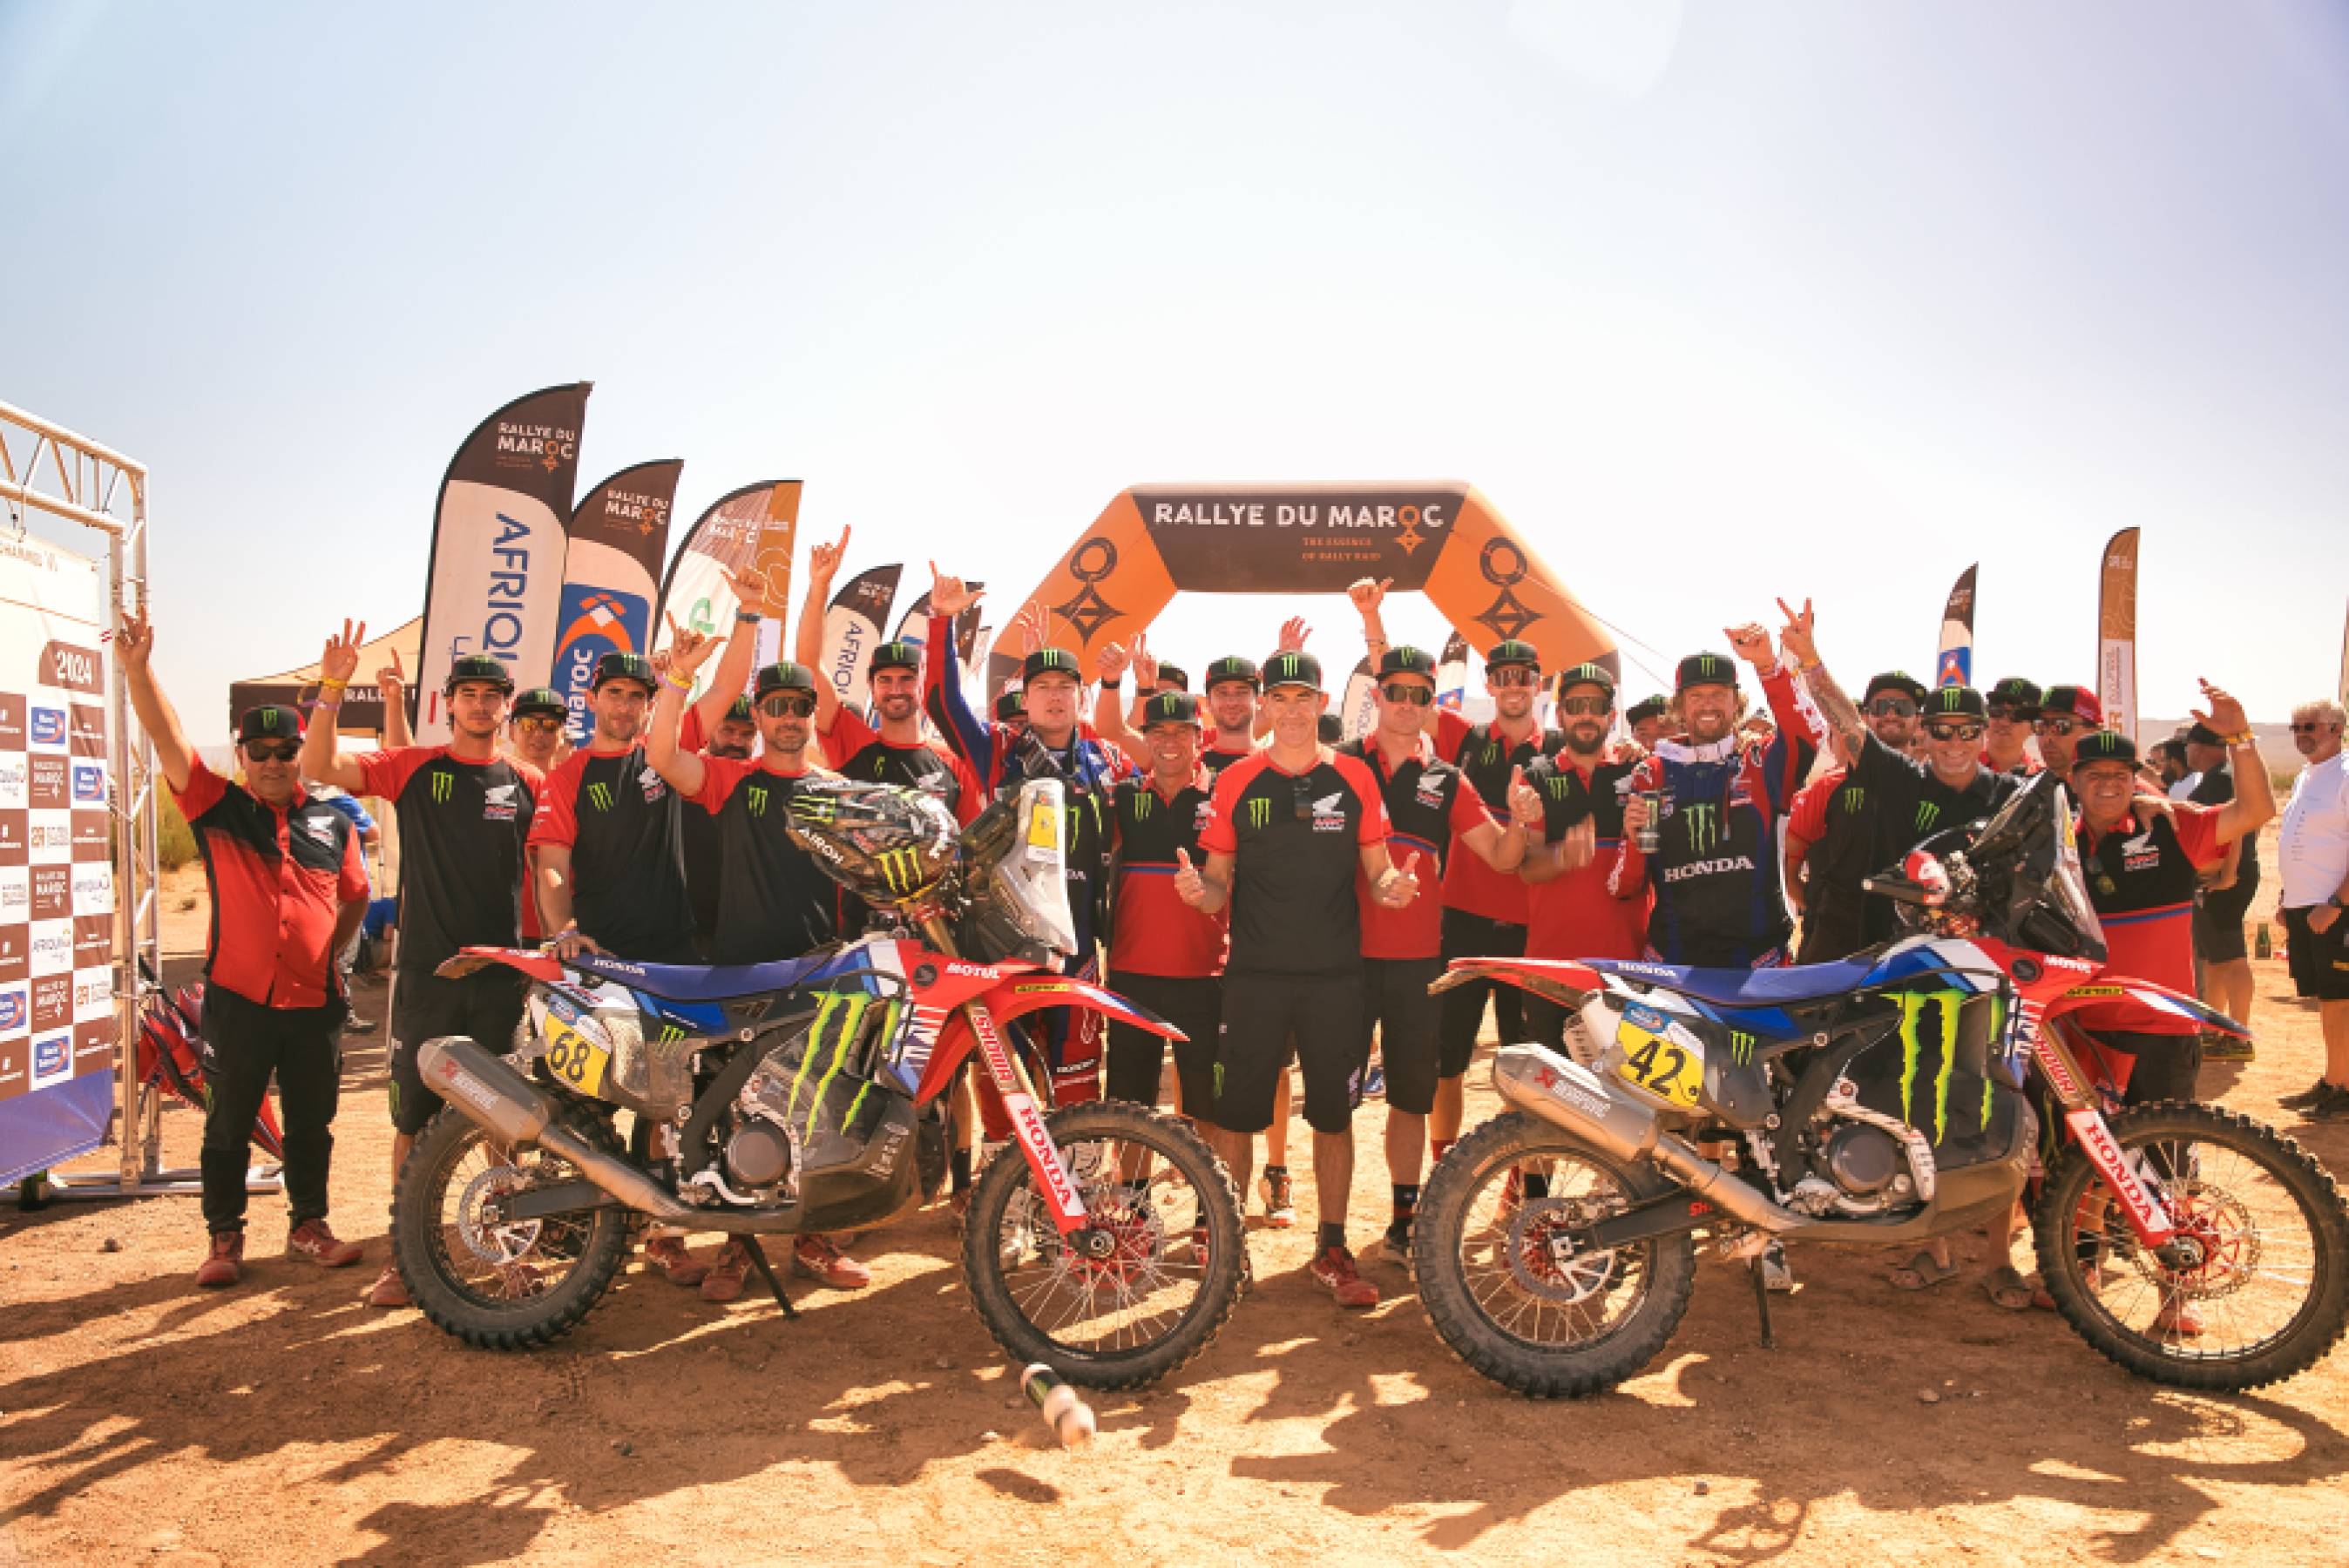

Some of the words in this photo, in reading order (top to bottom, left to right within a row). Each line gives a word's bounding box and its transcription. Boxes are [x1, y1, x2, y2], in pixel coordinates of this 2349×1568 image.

[498, 422, 552, 439] RALLYE
[556, 428, 575, 441] DU
[498, 436, 572, 459] MAROC
[607, 489, 650, 506] RALLYE
[653, 497, 669, 510] DU
[605, 501, 667, 525] MAROC
[1155, 503, 1264, 525] RALLYE
[1277, 504, 1317, 526] DU
[1328, 504, 1444, 528] MAROC
[1326, 537, 1372, 546] ESSENCE
[56, 650, 92, 686] 2024
[1663, 855, 1755, 882] HONDA
[946, 963, 1000, 980] MOTUL
[1617, 962, 1677, 977] HONDA
[551, 1031, 591, 1084] 68
[973, 1017, 1015, 1081] SHOWA
[1628, 1038, 1686, 1096] 42
[1019, 1106, 1073, 1206] HONDA
[2084, 1123, 2153, 1225] HONDA
